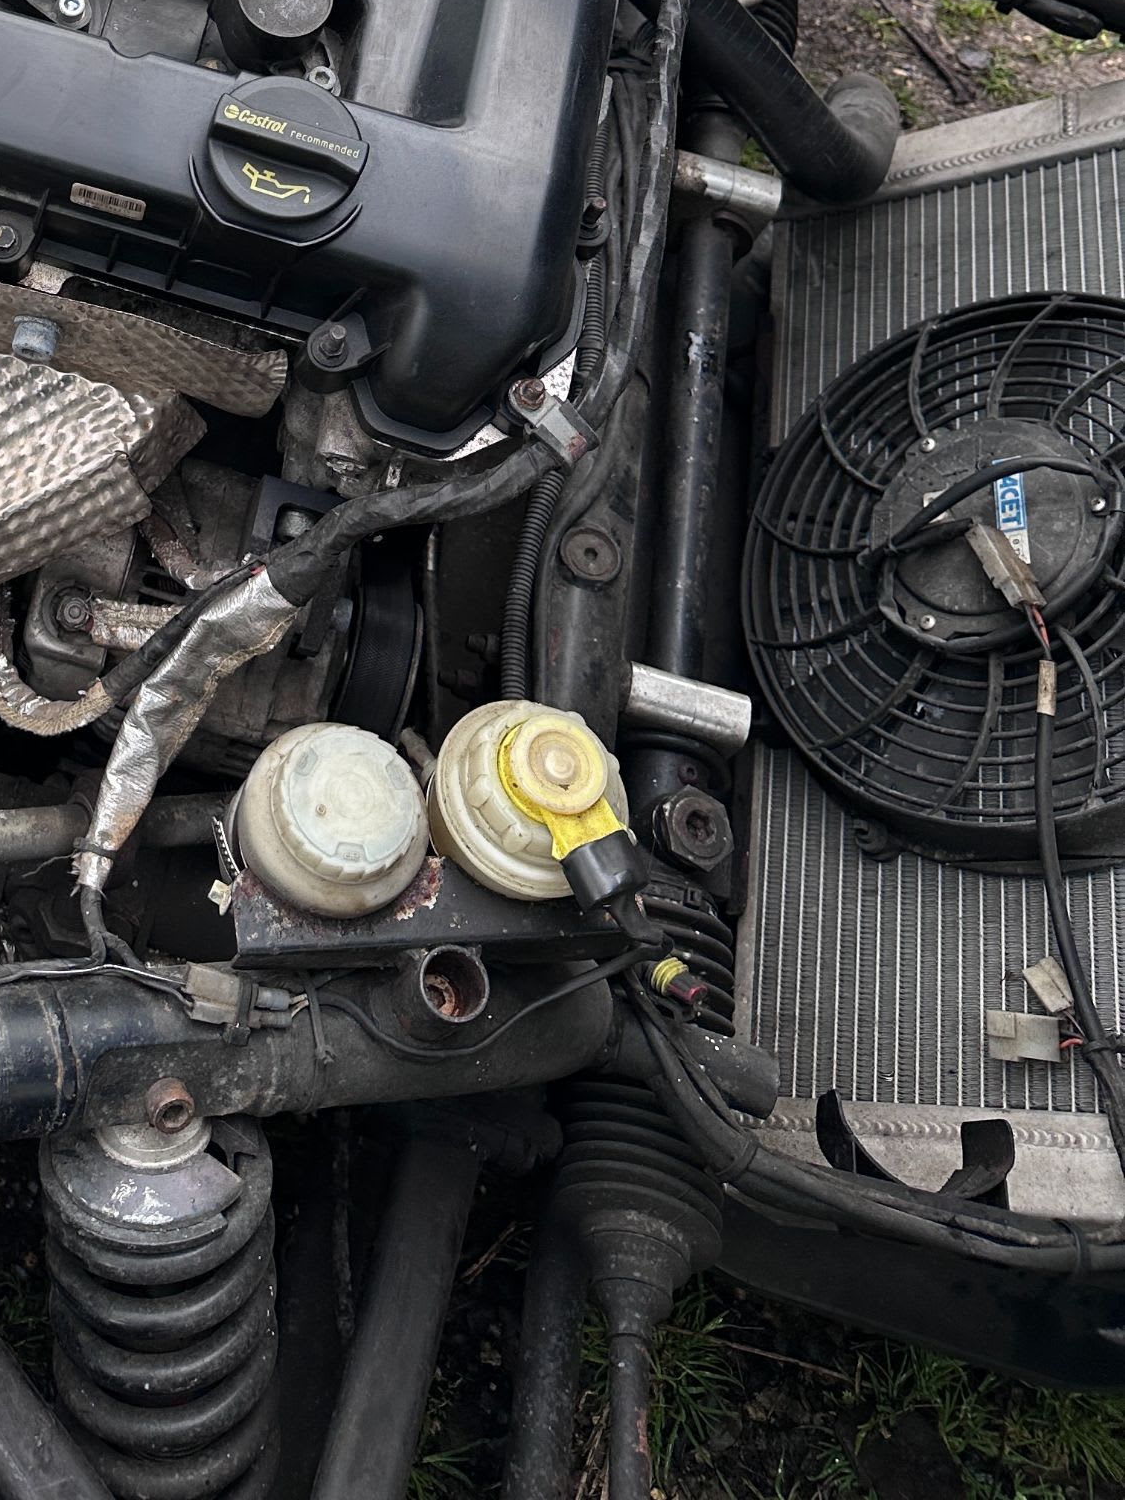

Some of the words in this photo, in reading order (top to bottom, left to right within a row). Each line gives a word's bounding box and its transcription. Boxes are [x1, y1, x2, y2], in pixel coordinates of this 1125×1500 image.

[238, 109, 288, 135] Castrol
[290, 130, 361, 159] recommended
[999, 475, 1023, 526] ACET
